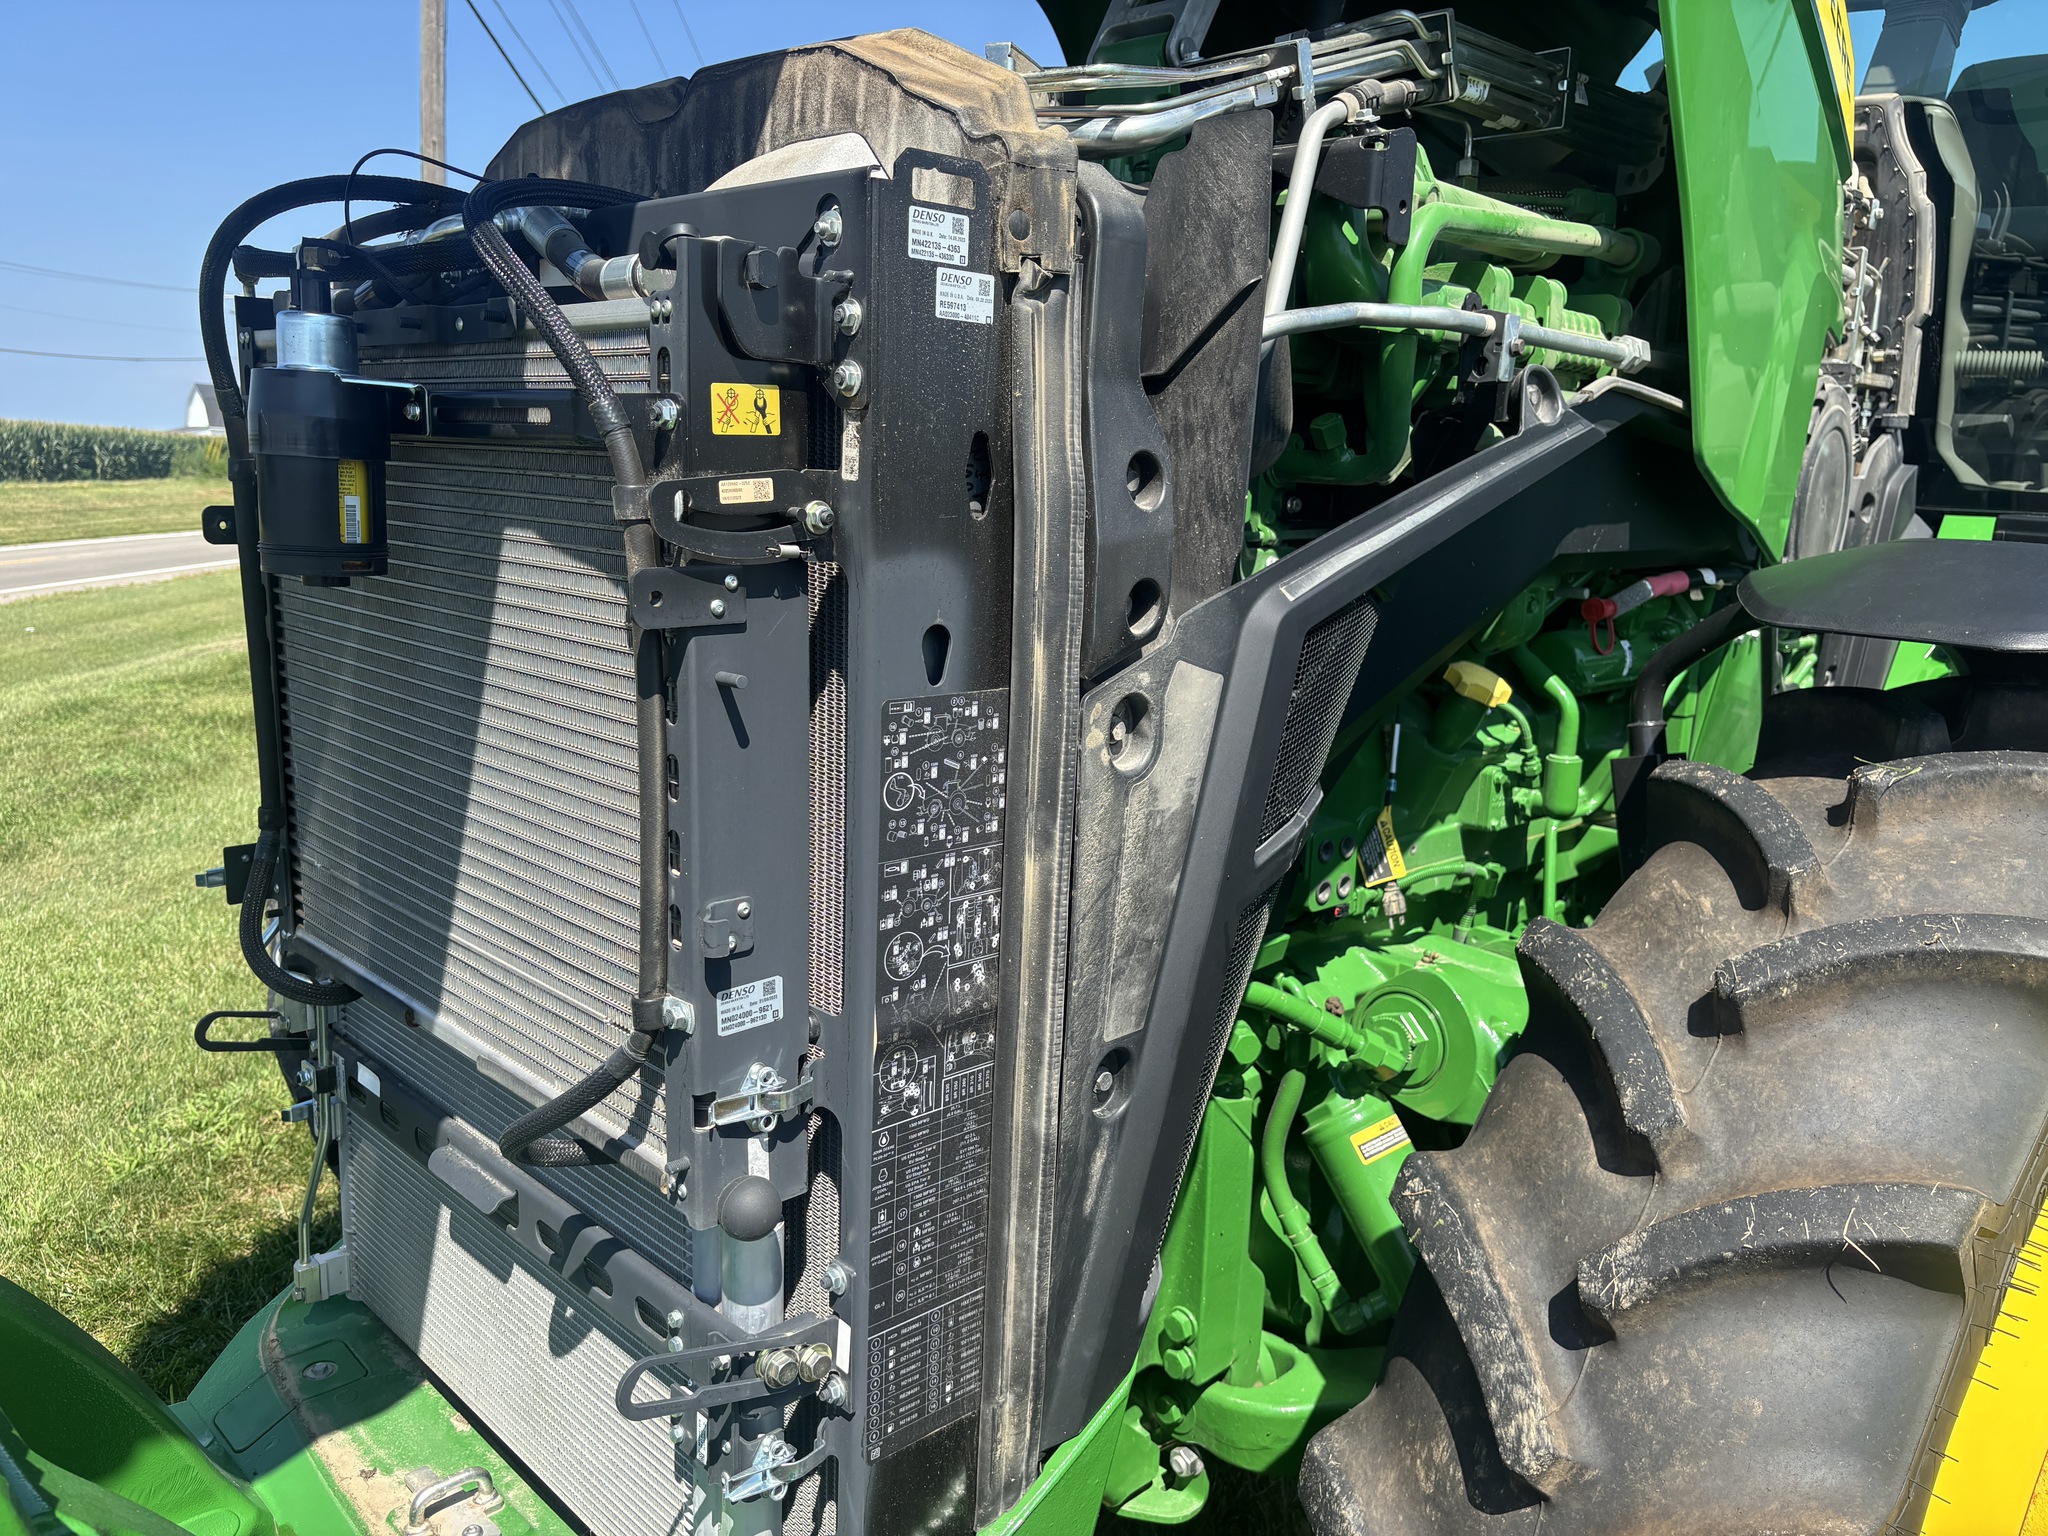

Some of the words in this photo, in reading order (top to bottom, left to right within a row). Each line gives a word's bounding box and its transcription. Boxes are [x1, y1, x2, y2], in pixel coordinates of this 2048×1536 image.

[912, 208, 946, 224] DENSO
[940, 272, 972, 286] DENSO
[1382, 828, 1401, 868] CAUTION
[721, 984, 756, 1002] DENSO
[923, 1196, 936, 1204] MFWD
[922, 1226, 935, 1234] MFWD
[921, 1241, 935, 1250] MFWD
[920, 1269, 933, 1278] MFWD
